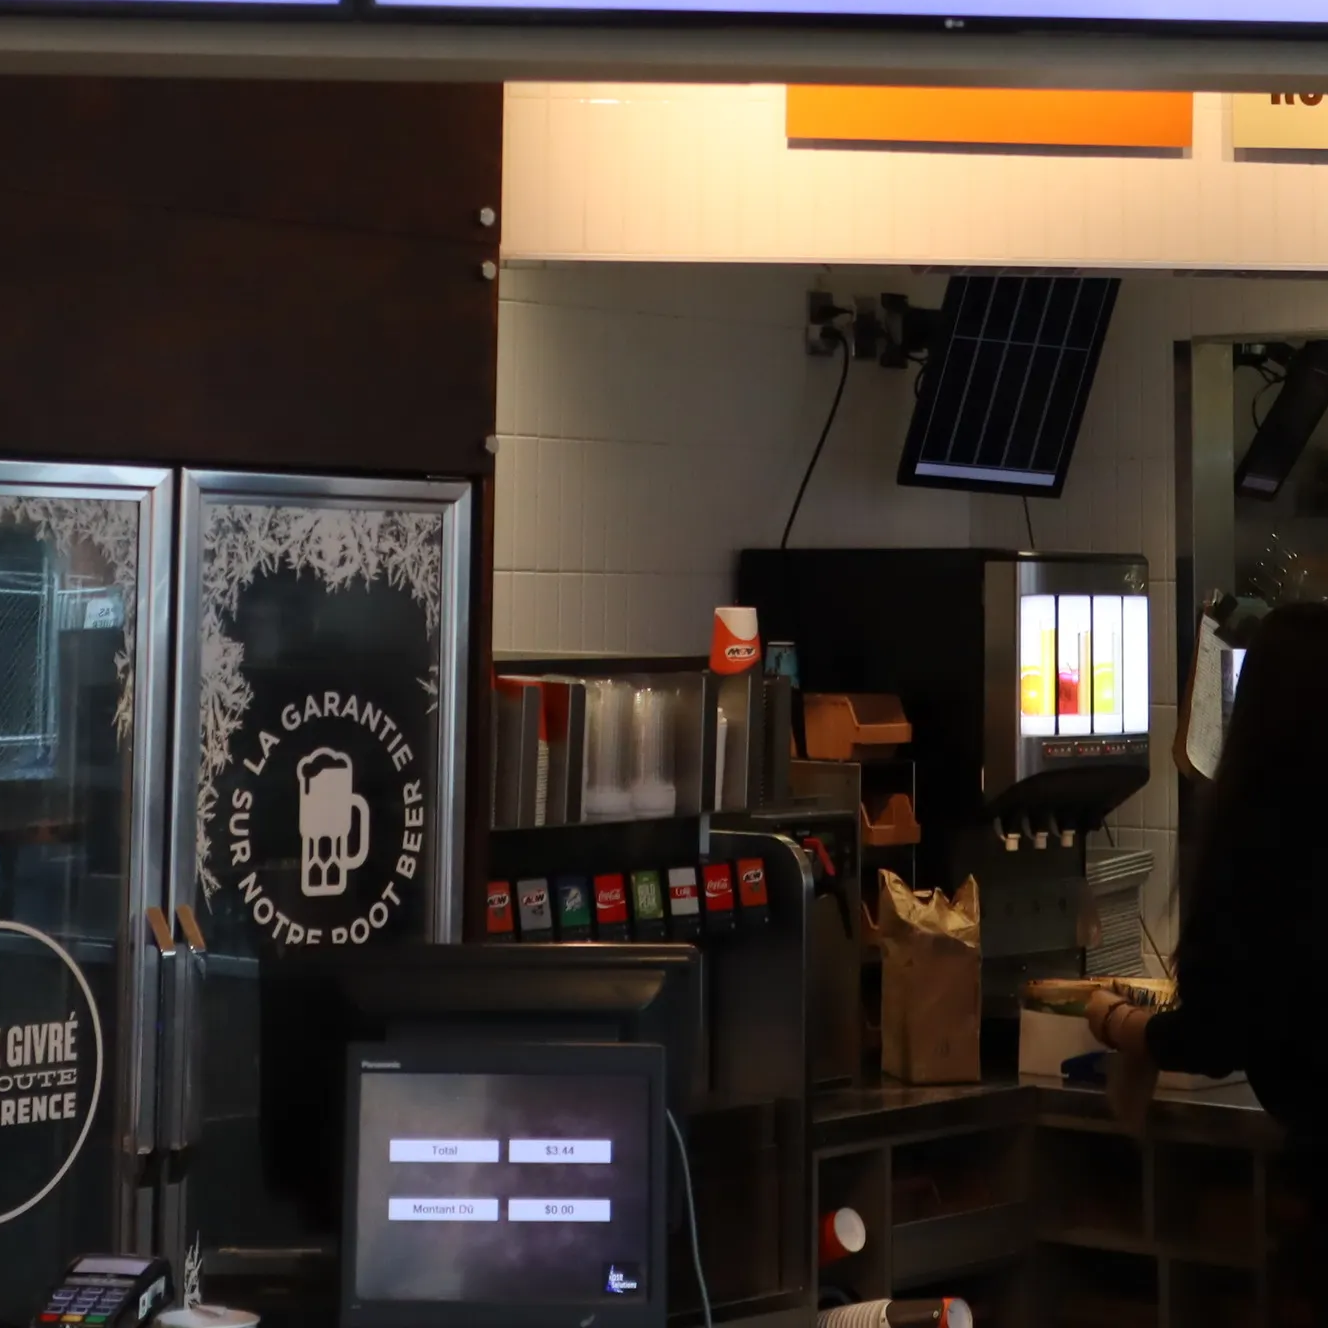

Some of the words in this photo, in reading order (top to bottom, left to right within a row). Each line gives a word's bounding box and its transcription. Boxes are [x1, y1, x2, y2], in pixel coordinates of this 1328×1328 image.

[243, 731, 280, 775] LA
[281, 692, 413, 771] GARANTIE
[229, 789, 252, 866] SUR
[396, 779, 423, 879] BEER
[238, 872, 322, 945] NOTRE
[6, 1012, 78, 1067] GIVRÉ
[432, 1145, 457, 1156] Total
[413, 1204, 455, 1215] Montant
